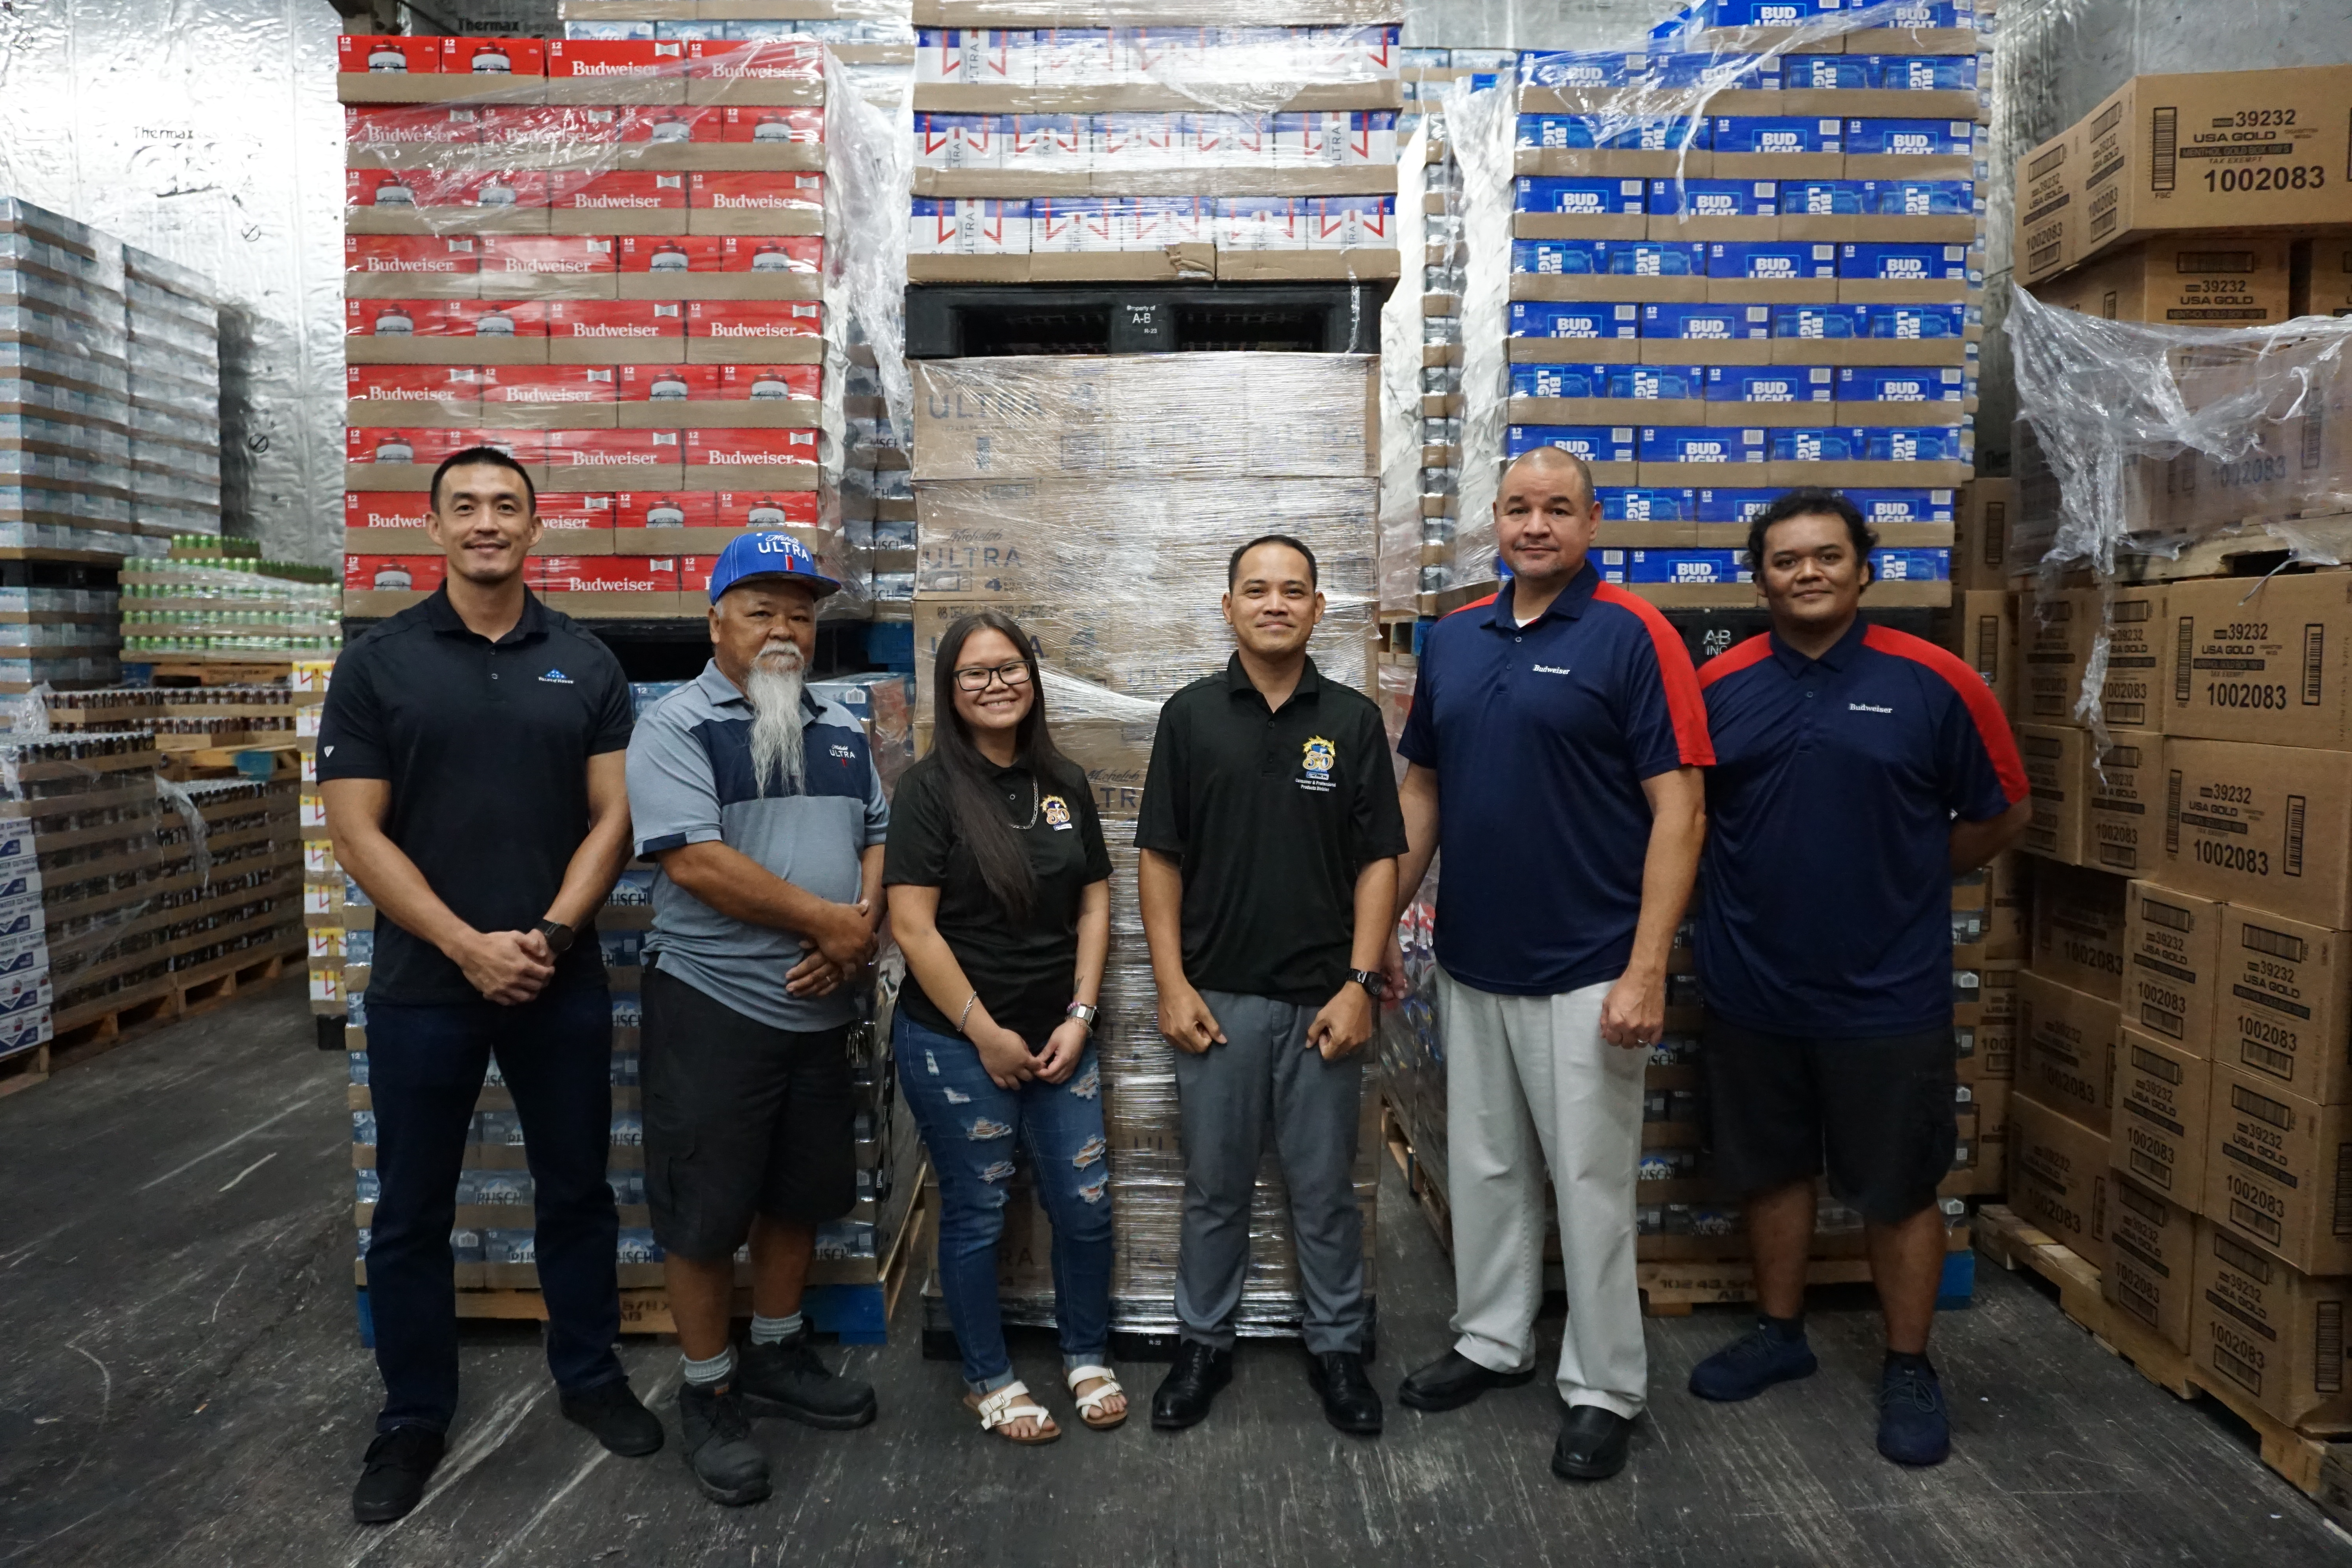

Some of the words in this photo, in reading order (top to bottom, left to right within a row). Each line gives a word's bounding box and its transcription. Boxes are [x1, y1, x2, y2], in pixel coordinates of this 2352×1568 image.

[1761, 7, 1797, 19] BUD
[1895, 8, 1931, 20] BUD
[458, 19, 519, 32] Thermax
[572, 61, 659, 75] Budweiser
[2236, 109, 2296, 127] 39232
[368, 126, 453, 142] Budweiser
[1762, 132, 1797, 145] BUD
[1893, 134, 1928, 147] BUD
[2194, 132, 2228, 143] USA
[2232, 131, 2276, 141] GOLD
[2204, 165, 2325, 192] 1002083
[575, 194, 661, 208] Budweiser
[713, 194, 799, 208] Budweiser
[1563, 193, 1599, 205] BUD
[1696, 196, 1732, 208] BUD
[1808, 187, 1820, 214] LIG
[1820, 194, 1832, 214] BU
[367, 257, 454, 272] Budweiser
[505, 258, 590, 272] Budweiser
[1538, 247, 1550, 274] LIG
[1550, 254, 1562, 274] BU
[1755, 258, 1791, 270] BUD
[1887, 259, 1922, 271] BUD
[2202, 280, 2246, 293] 39232
[2180, 296, 2212, 305] USA
[2214, 295, 2254, 305] GOLD
[1132, 313, 1151, 323] A-B
[1557, 318, 1593, 330] BUD
[573, 323, 659, 336] Budweiser
[711, 322, 796, 336] Budweiser
[1689, 320, 1724, 332] BUD
[369, 386, 455, 401] Budweiser
[506, 387, 589, 401] Budweiser
[1753, 381, 1788, 394] BUD
[1884, 381, 1920, 394] BUD
[1687, 443, 1721, 455] BUD
[572, 451, 657, 465] Budweiser
[708, 450, 793, 465] Budweiser
[1875, 503, 1908, 515] BUD
[368, 514, 427, 528] Budwei
[766, 535, 799, 545] Michelob
[758, 541, 809, 562] ULTRA
[926, 548, 1021, 568] ULTRA
[1677, 563, 1711, 576] BUD
[570, 577, 654, 591] Budweiser
[985, 577, 1002, 591] 4
[1703, 630, 1731, 644] A-B
[2118, 629, 2143, 641] 39232
[2228, 624, 2268, 640] 39232
[2202, 645, 2223, 655] USA
[2225, 645, 2254, 655] GOLD
[1533, 665, 1570, 674] Budweiser
[2103, 683, 2147, 699] 1002083
[2207, 682, 2287, 710] 1002083
[1849, 703, 1893, 713] Budweiser
[829, 749, 855, 759] ULTRA
[1303, 751, 1334, 770] 50
[1087, 769, 1140, 783] Michelob
[2213, 783, 2252, 804] 39232
[2189, 801, 2209, 812] USA
[2210, 804, 2238, 817] GOLD
[1047, 808, 1070, 825] 50
[2096, 824, 2138, 844] 1002083
[2194, 839, 2269, 876] 1002083
[2156, 931, 2184, 952] 39232
[2142, 943, 2160, 956] USA
[2162, 950, 2187, 965] GOLD
[2260, 960, 2295, 984] 39232
[2243, 973, 2267, 989] USA
[2269, 982, 2300, 999] GOLD
[2138, 981, 2186, 1014] 1002083
[2238, 1015, 2297, 1052] 1002083
[2145, 1080, 2173, 1103] 39232
[2132, 1089, 2151, 1105] USA
[2152, 1099, 2176, 1117] GOLD
[2249, 1123, 2283, 1151] 39232
[2127, 1127, 2174, 1164] 1002083
[2233, 1133, 2255, 1152] USA
[2258, 1145, 2288, 1166] GOLD
[2227, 1175, 2284, 1218] 1002083
[2229, 1273, 2262, 1303] 39232
[2238, 1296, 2267, 1320] GOLD
[2210, 1321, 2265, 1369] 1002083
